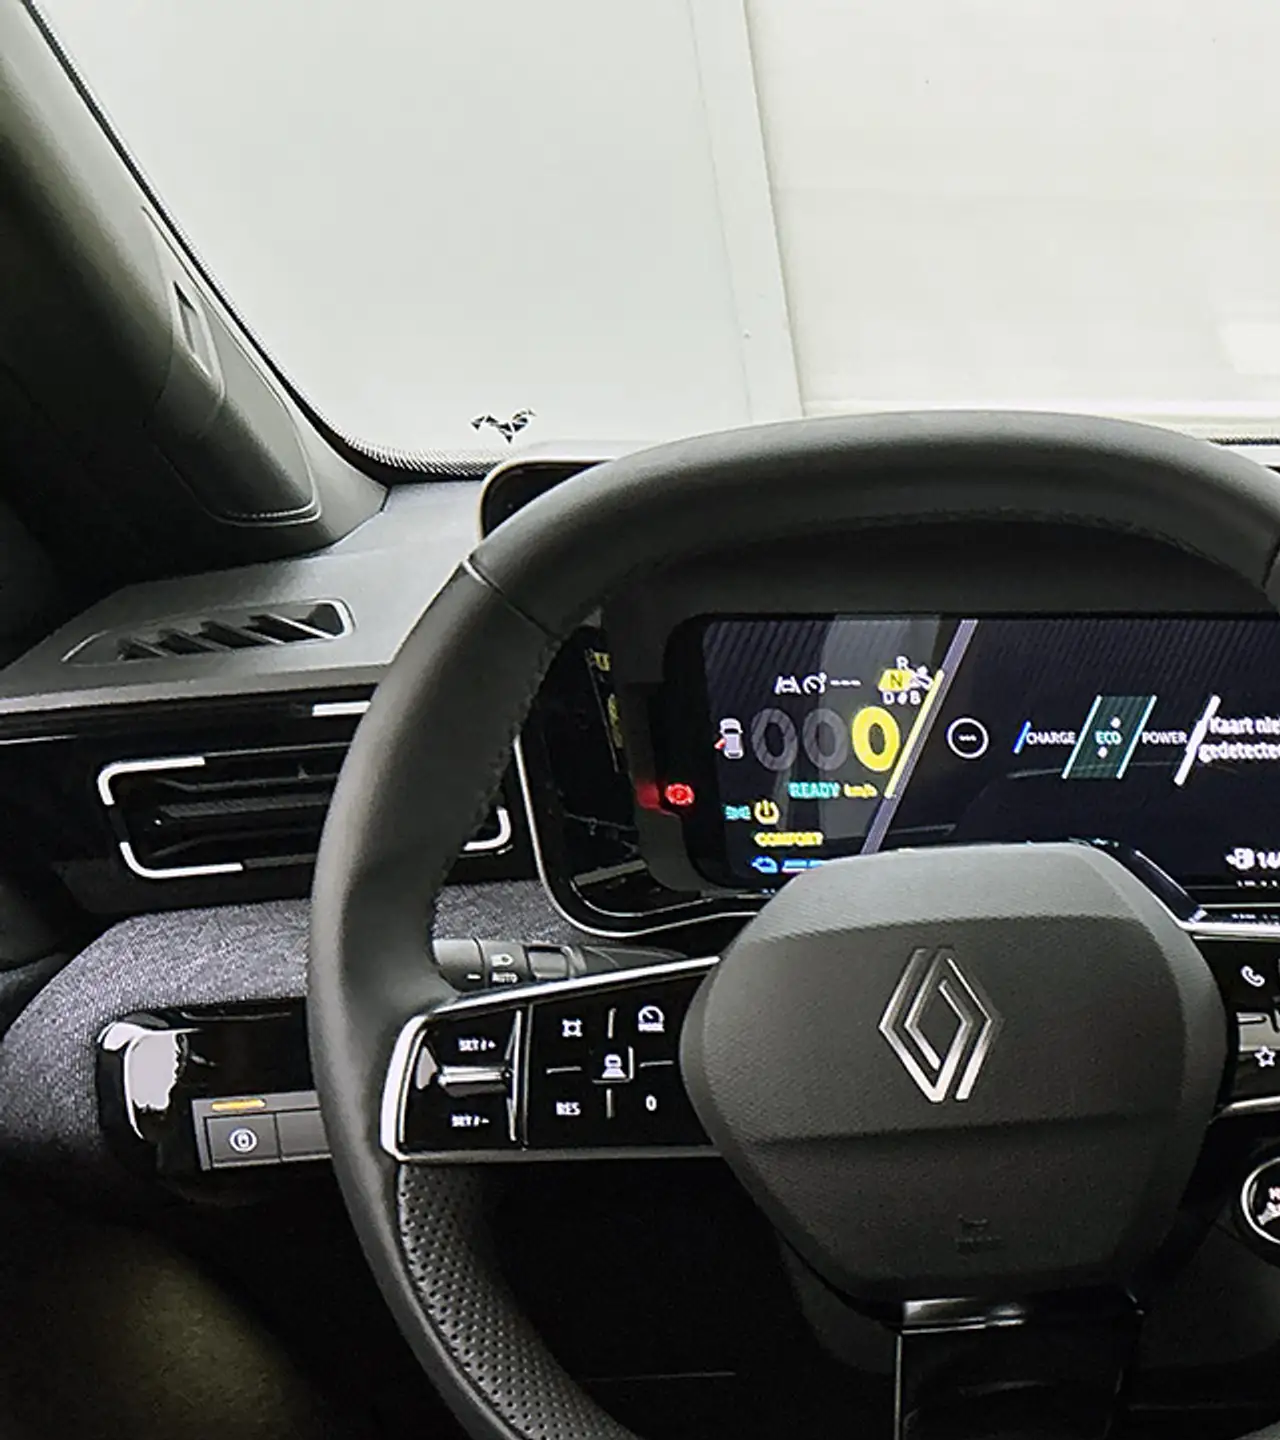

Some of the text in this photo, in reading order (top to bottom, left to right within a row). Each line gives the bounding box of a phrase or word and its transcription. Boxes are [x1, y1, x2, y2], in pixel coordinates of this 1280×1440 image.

[1210, 716, 1255, 735] Kaart
[1027, 730, 1187, 746] CHARGE ECO POWER
[788, 782, 840, 799] READY
